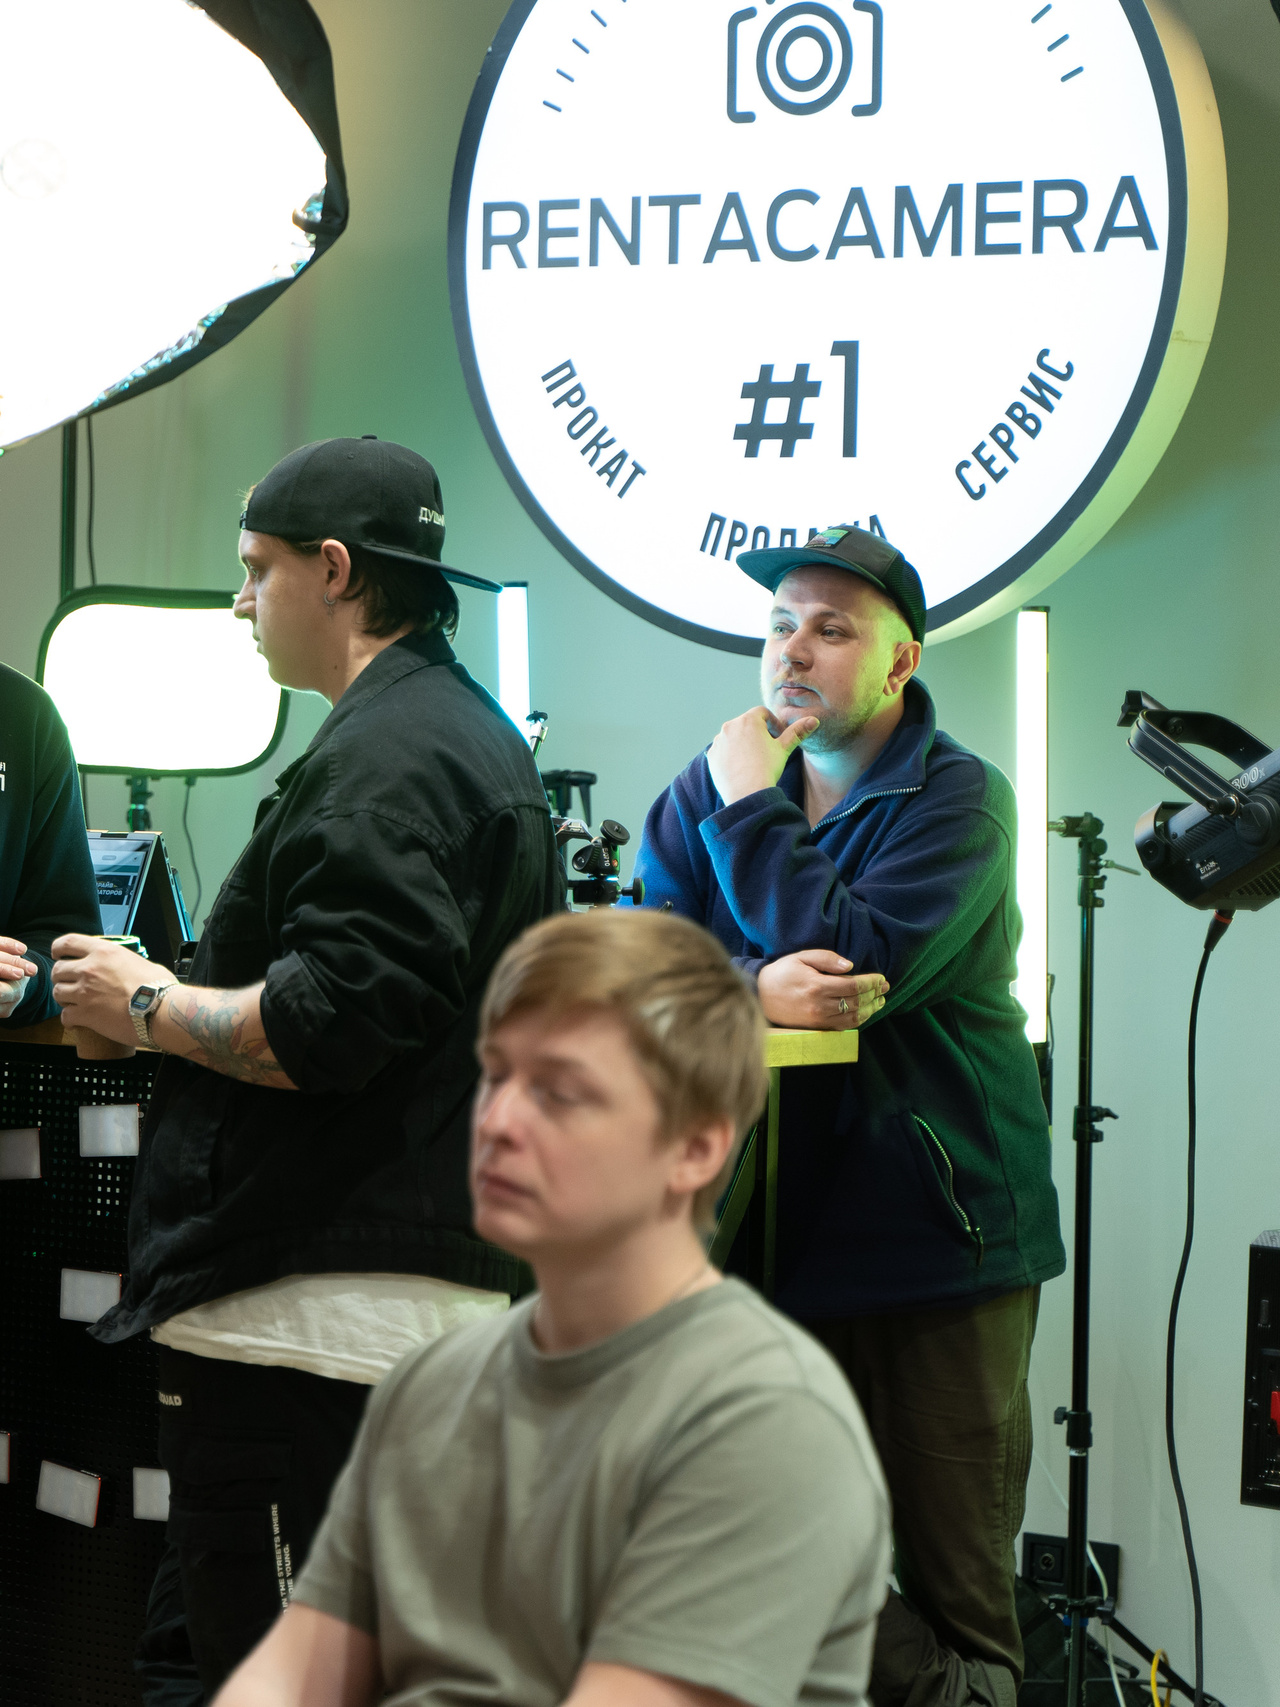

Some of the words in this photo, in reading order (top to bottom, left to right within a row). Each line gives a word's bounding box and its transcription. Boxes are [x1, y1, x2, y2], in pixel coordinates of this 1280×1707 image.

[482, 175, 1159, 270] RENTACAMERA
[541, 359, 647, 499] ПРОКАТ
[733, 340, 860, 458] #1
[955, 348, 1075, 501] СЕРВИС
[271, 1503, 280, 1535] WHERE
[274, 1536, 285, 1578] STREETS
[279, 1578, 287, 1598] THE
